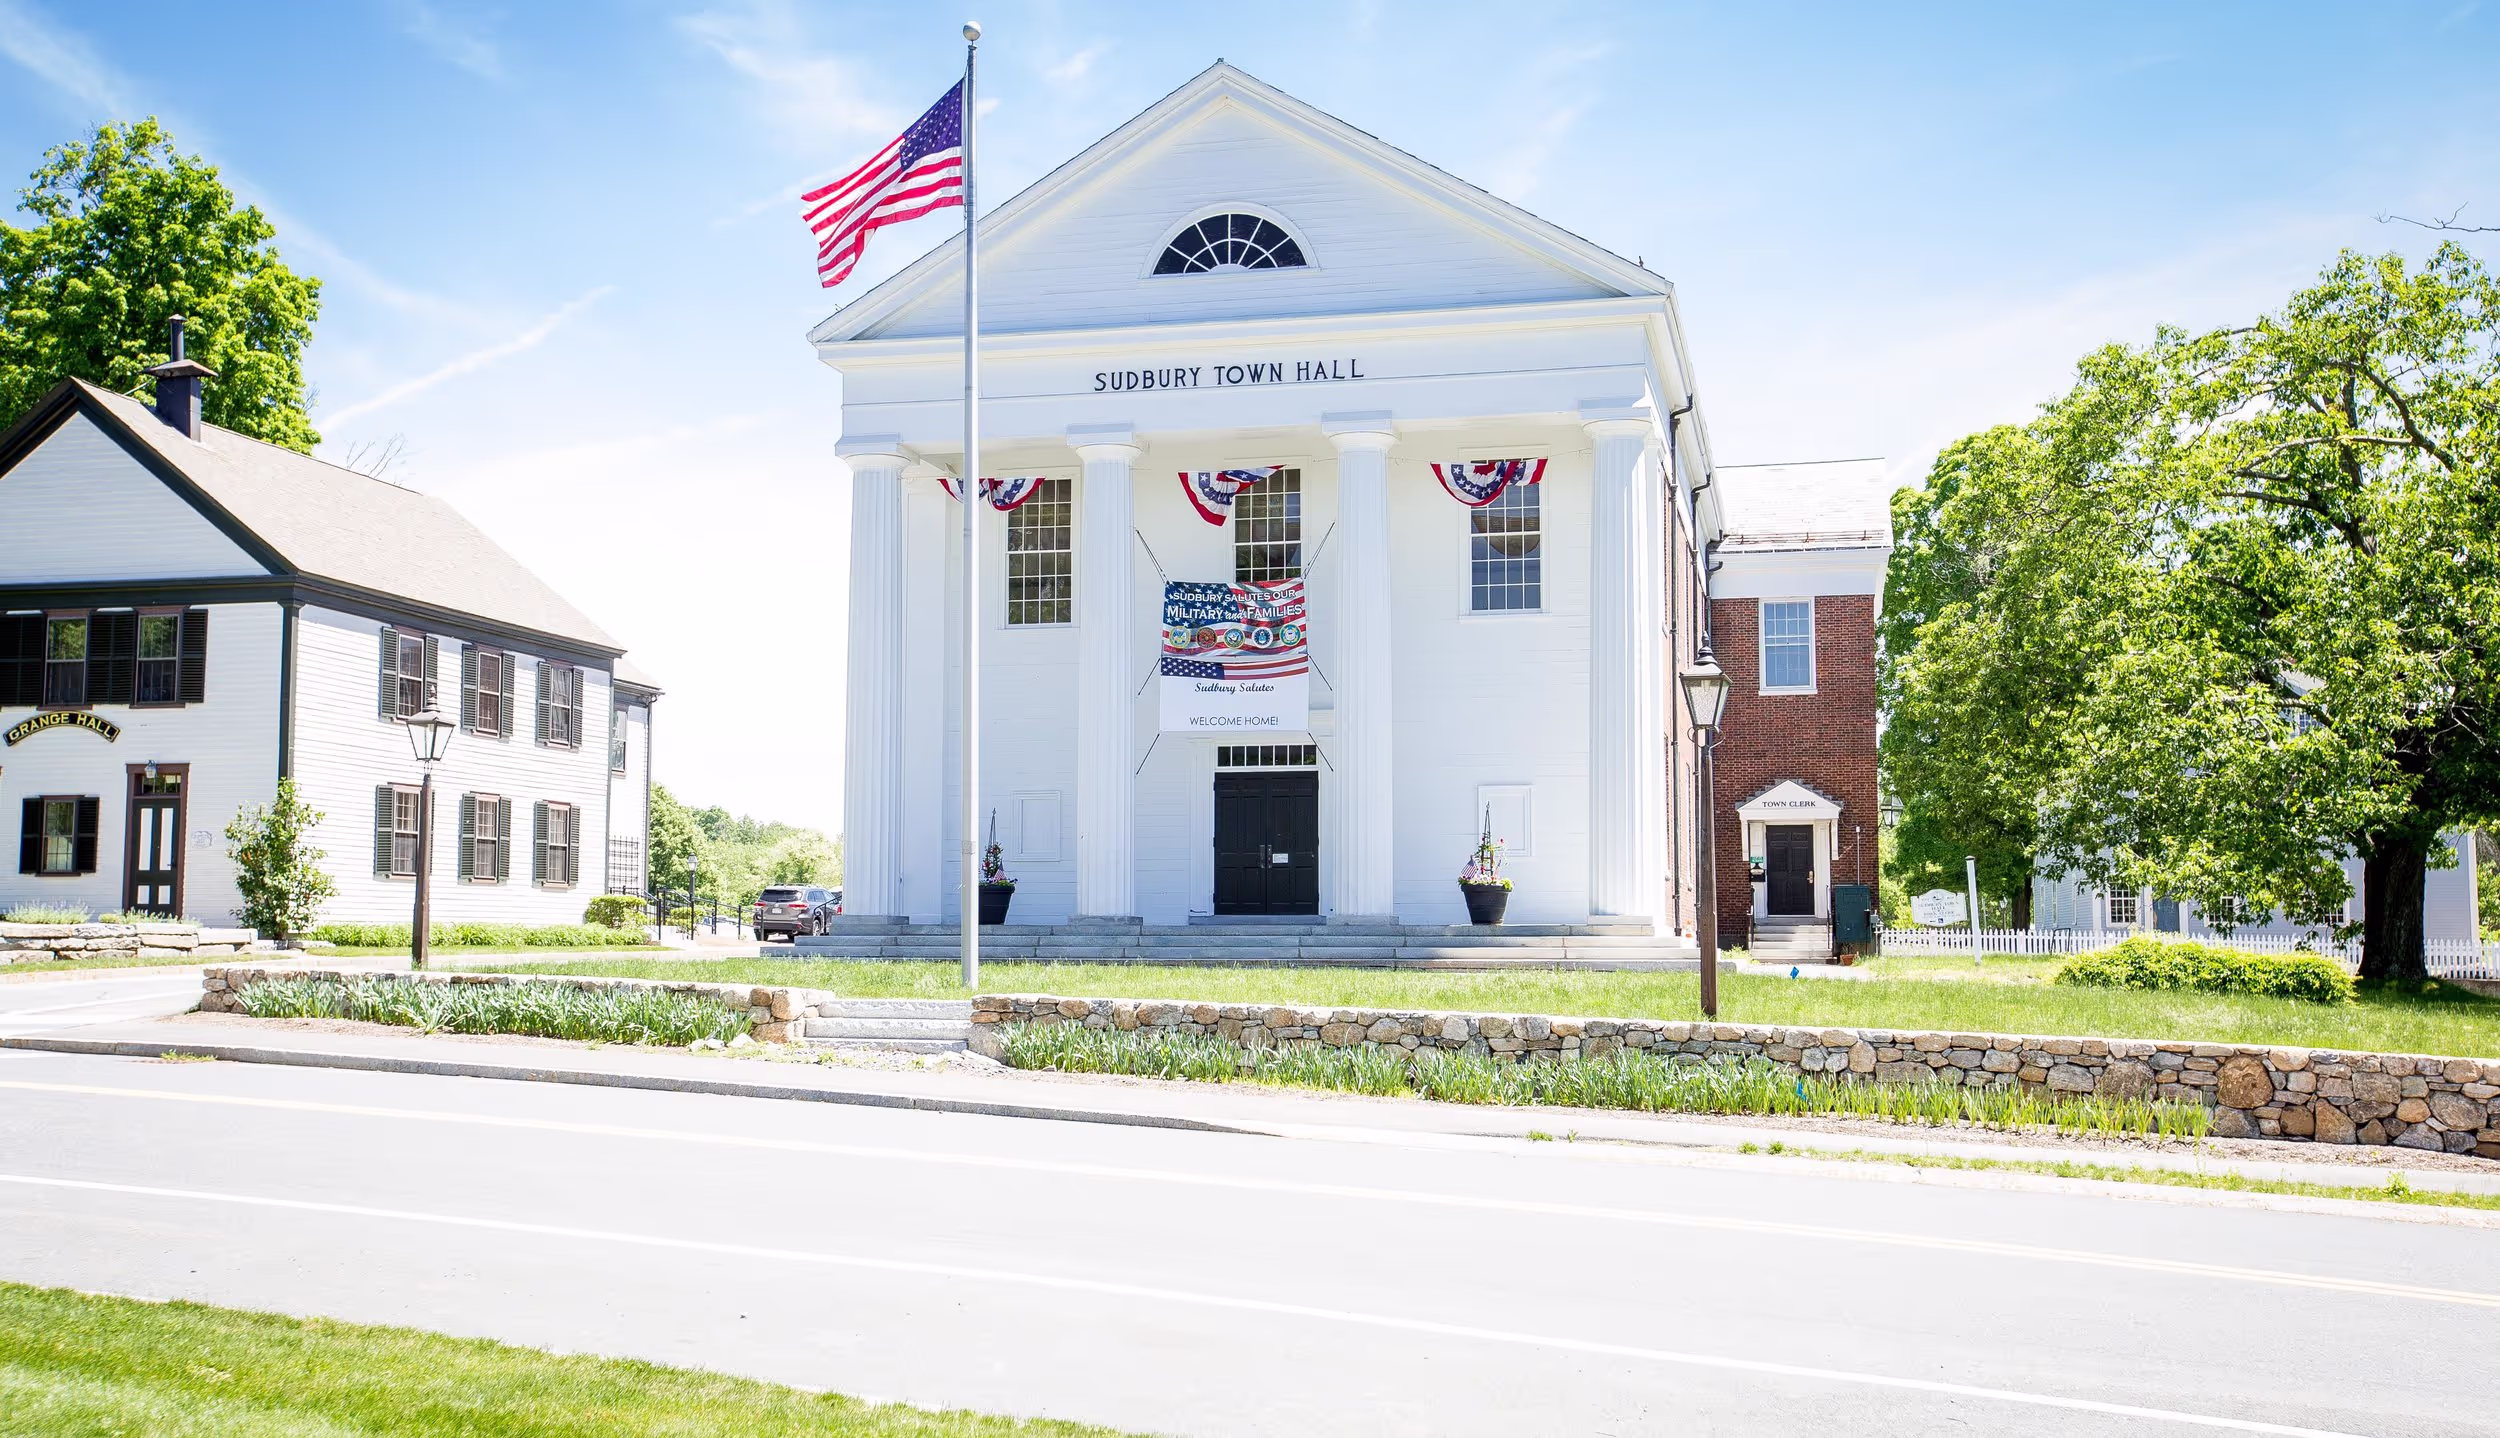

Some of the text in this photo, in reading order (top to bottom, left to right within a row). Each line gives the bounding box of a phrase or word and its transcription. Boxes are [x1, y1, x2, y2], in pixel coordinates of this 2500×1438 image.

[1094, 358, 1364, 391] SUDBURY TOWN HALL
[1173, 589, 1295, 602] SUDBURY SALUTES OUR
[1167, 604, 1303, 620] MILITARY and FAMILIES
[1194, 682, 1275, 695] Sudbury Salutes
[9, 713, 112, 741] GRANGE HALL
[1189, 716, 1279, 726] WELCOME HOME!
[1789, 800, 1816, 808] CLERK
